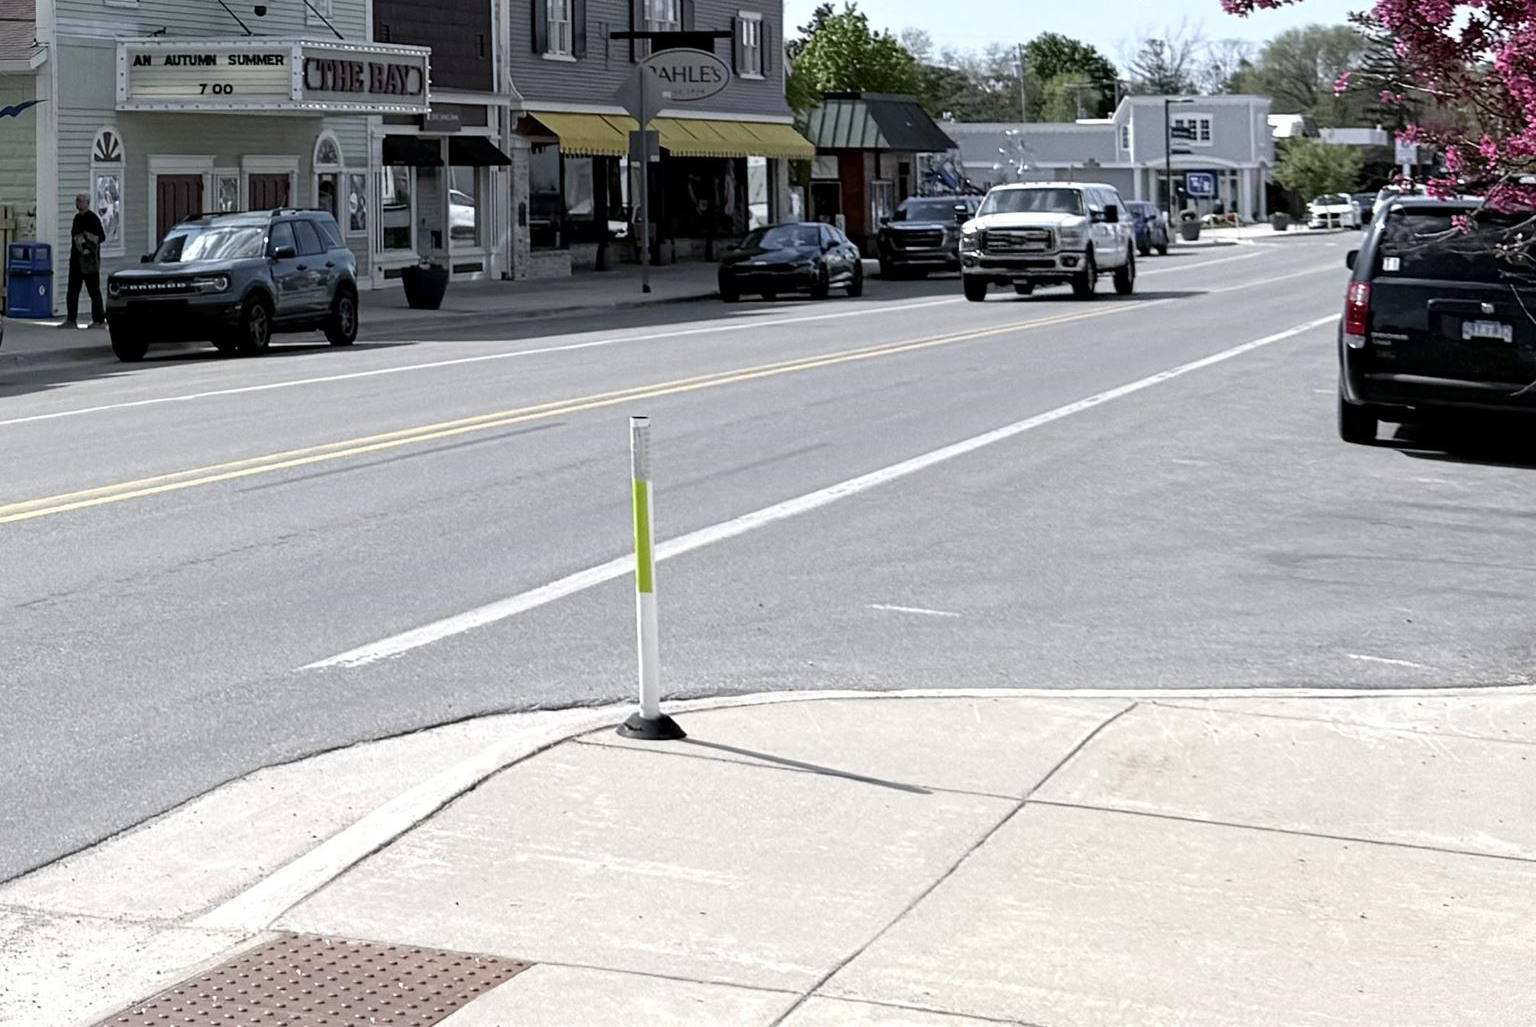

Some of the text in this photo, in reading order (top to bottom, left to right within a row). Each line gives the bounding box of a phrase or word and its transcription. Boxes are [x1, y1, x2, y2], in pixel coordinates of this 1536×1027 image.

[133, 54, 284, 66] AN AUTUMN SUMMER
[312, 58, 413, 95] THE BAY
